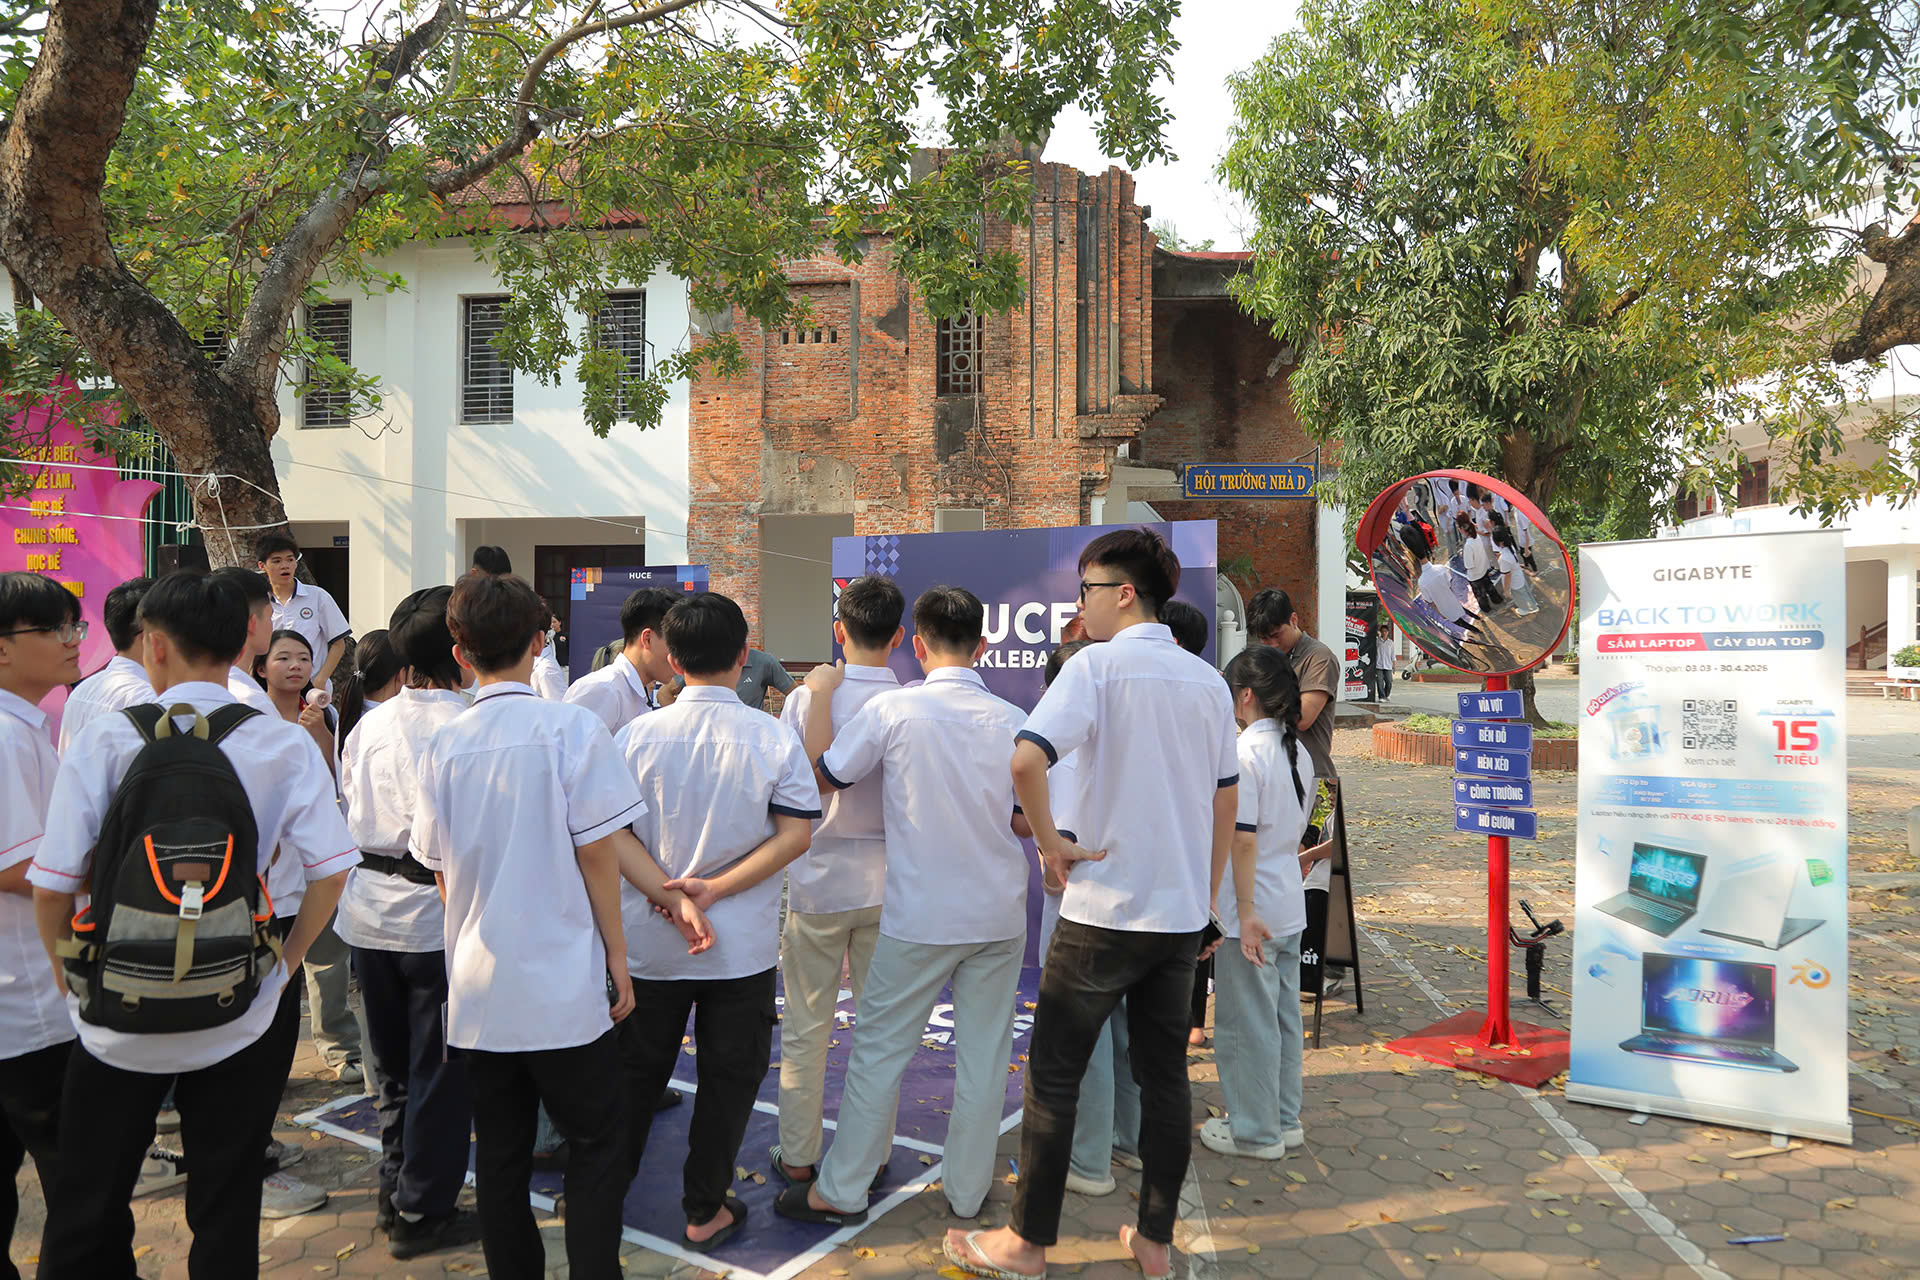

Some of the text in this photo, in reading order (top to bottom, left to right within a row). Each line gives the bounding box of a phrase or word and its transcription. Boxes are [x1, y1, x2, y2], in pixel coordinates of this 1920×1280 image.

[1194, 468, 1306, 494] HỘI TRƯỜNG NHÀ D
[14, 522, 79, 545] CHUNG SỐNG,
[27, 554, 46, 573] HỌC
[628, 571, 653, 580] HUCE
[1652, 565, 1753, 582] GIGABYTE
[1597, 602, 1822, 627] BACK TO WORK
[1607, 634, 1812, 649] SẮM LAPTOP CÀY ĐUA TOP
[1478, 726, 1494, 743] BẾN
[1772, 720, 1819, 751] 15
[1774, 753, 1819, 766] TRIỆU
[1470, 783, 1524, 801] CÔNG TRƯỜNG
